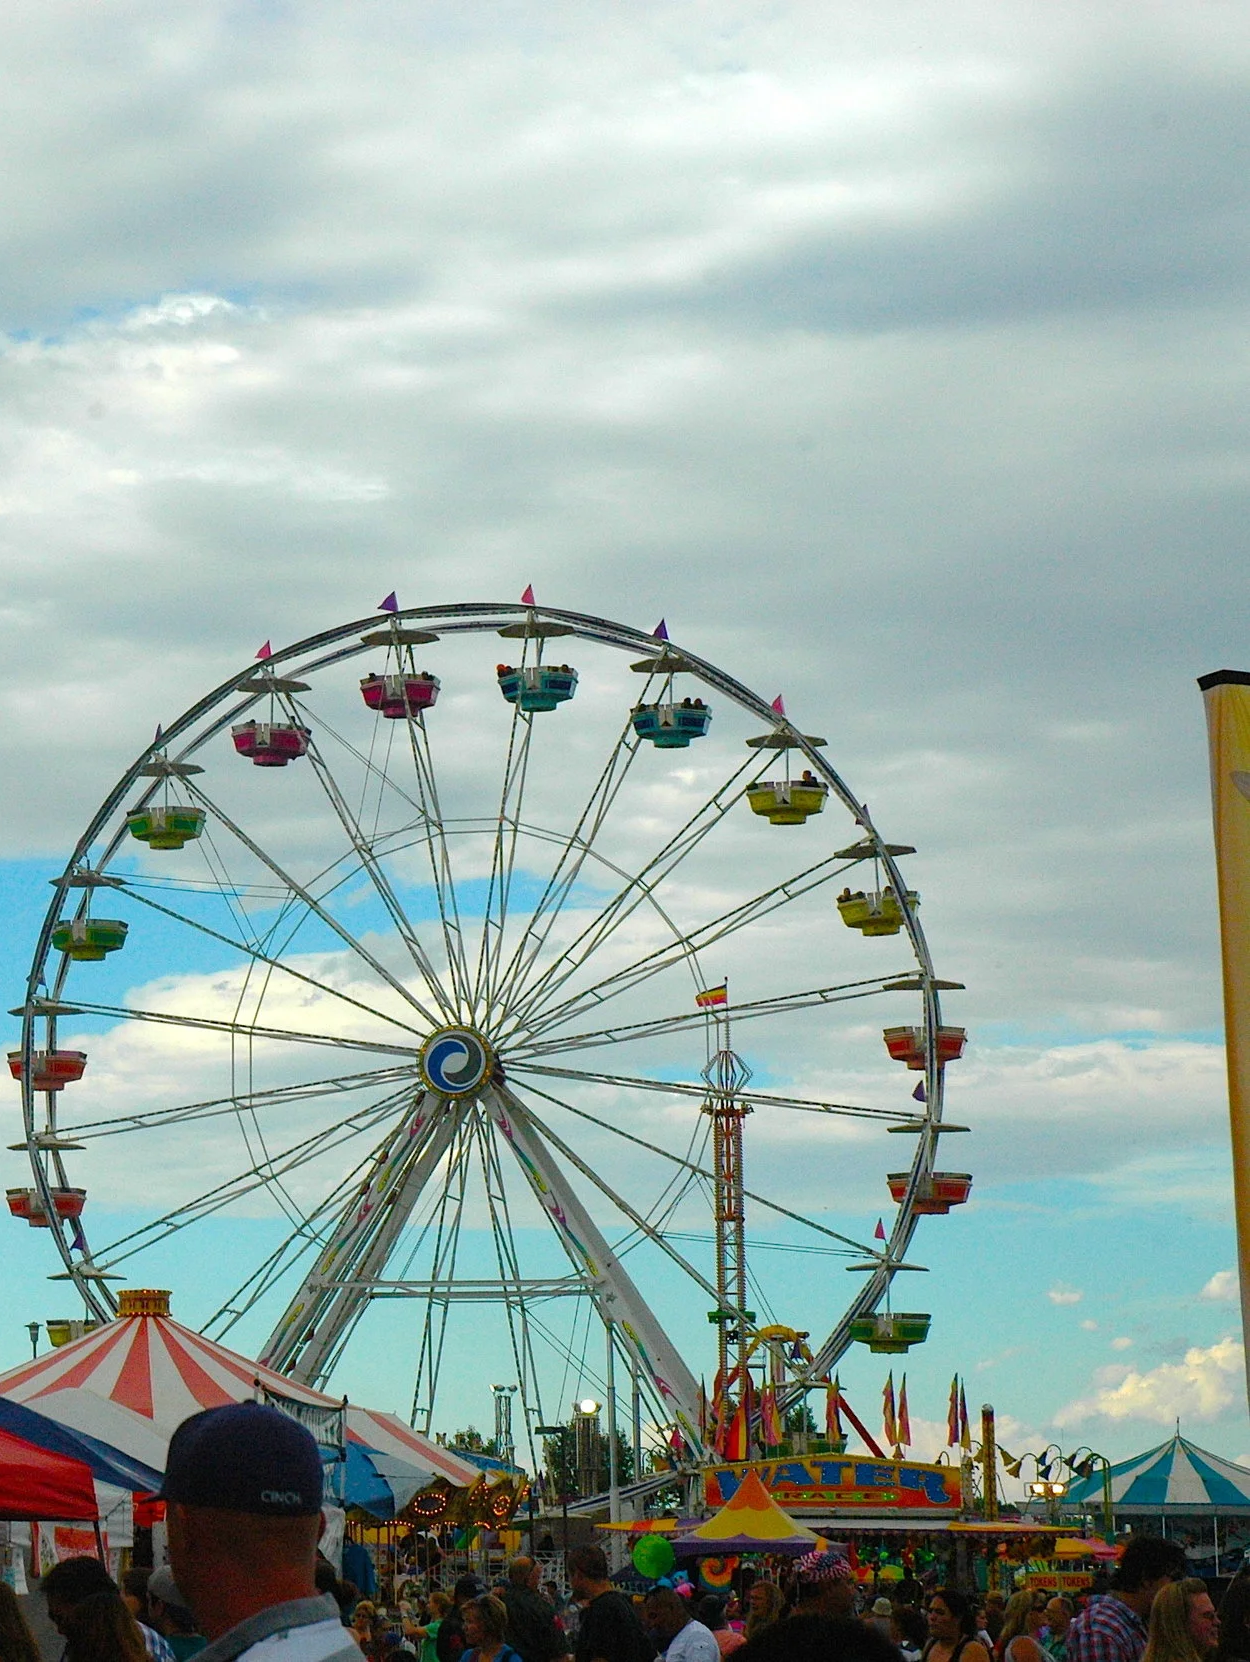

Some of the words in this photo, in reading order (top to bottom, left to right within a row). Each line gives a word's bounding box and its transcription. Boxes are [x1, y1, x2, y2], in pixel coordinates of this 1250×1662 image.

[714, 1461, 954, 1504] WATER
[783, 1491, 884, 1501] RACE
[1029, 1576, 1057, 1588] TOKENS
[1062, 1576, 1092, 1588] TOKENS
